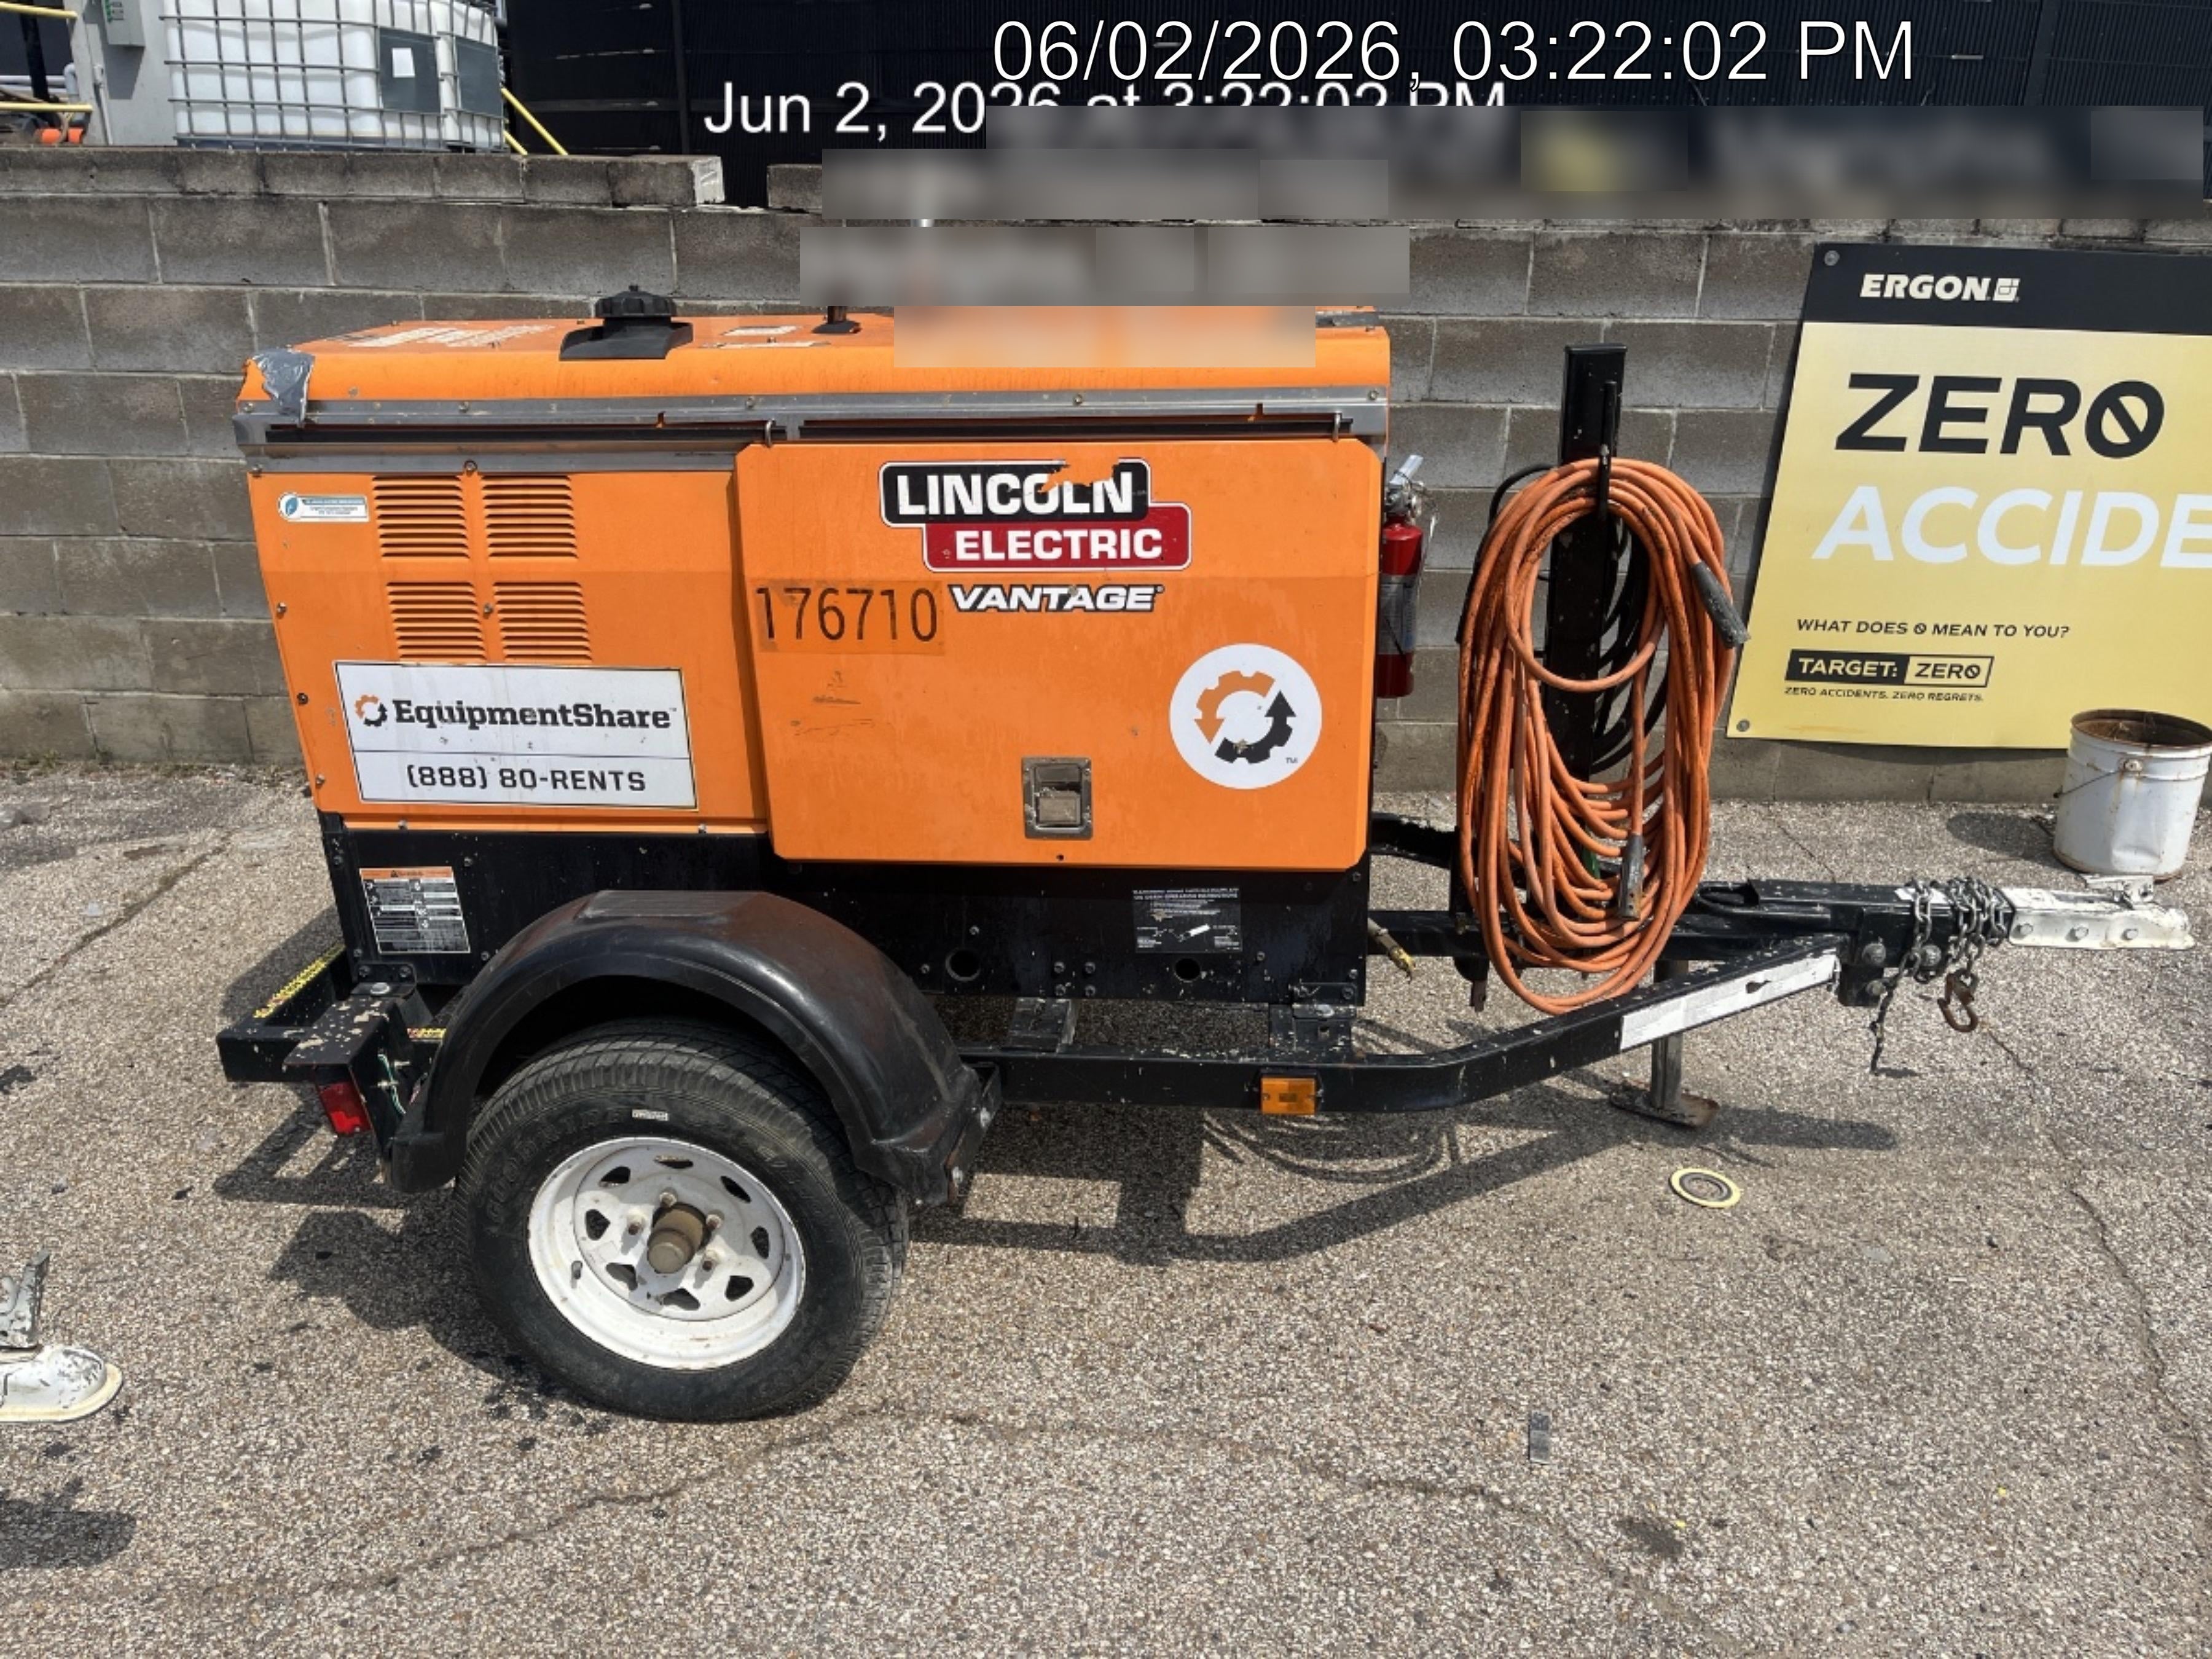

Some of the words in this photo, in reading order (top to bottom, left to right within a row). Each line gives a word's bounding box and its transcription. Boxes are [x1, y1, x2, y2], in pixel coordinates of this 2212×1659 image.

[1859, 273, 1991, 301] ERGON
[1835, 373, 2165, 459] ZERO
[896, 471, 1133, 516] LINCOLN
[1811, 485, 2212, 568] ACCIDE
[955, 528, 1163, 560] ELECTRIC
[755, 587, 938, 642] 176710
[1797, 619, 1851, 632] WHAT
[1856, 621, 1908, 635] DOES
[1932, 624, 1988, 637] MEAN
[1993, 624, 2017, 637] TO
[2023, 626, 2069, 638] YOU?
[1798, 657, 1898, 677] TARGET:
[1914, 662, 1982, 680] ZERO
[1784, 687, 1816, 696] ZERO
[406, 764, 488, 789] (888)
[498, 768, 646, 791] 80-RENTS
